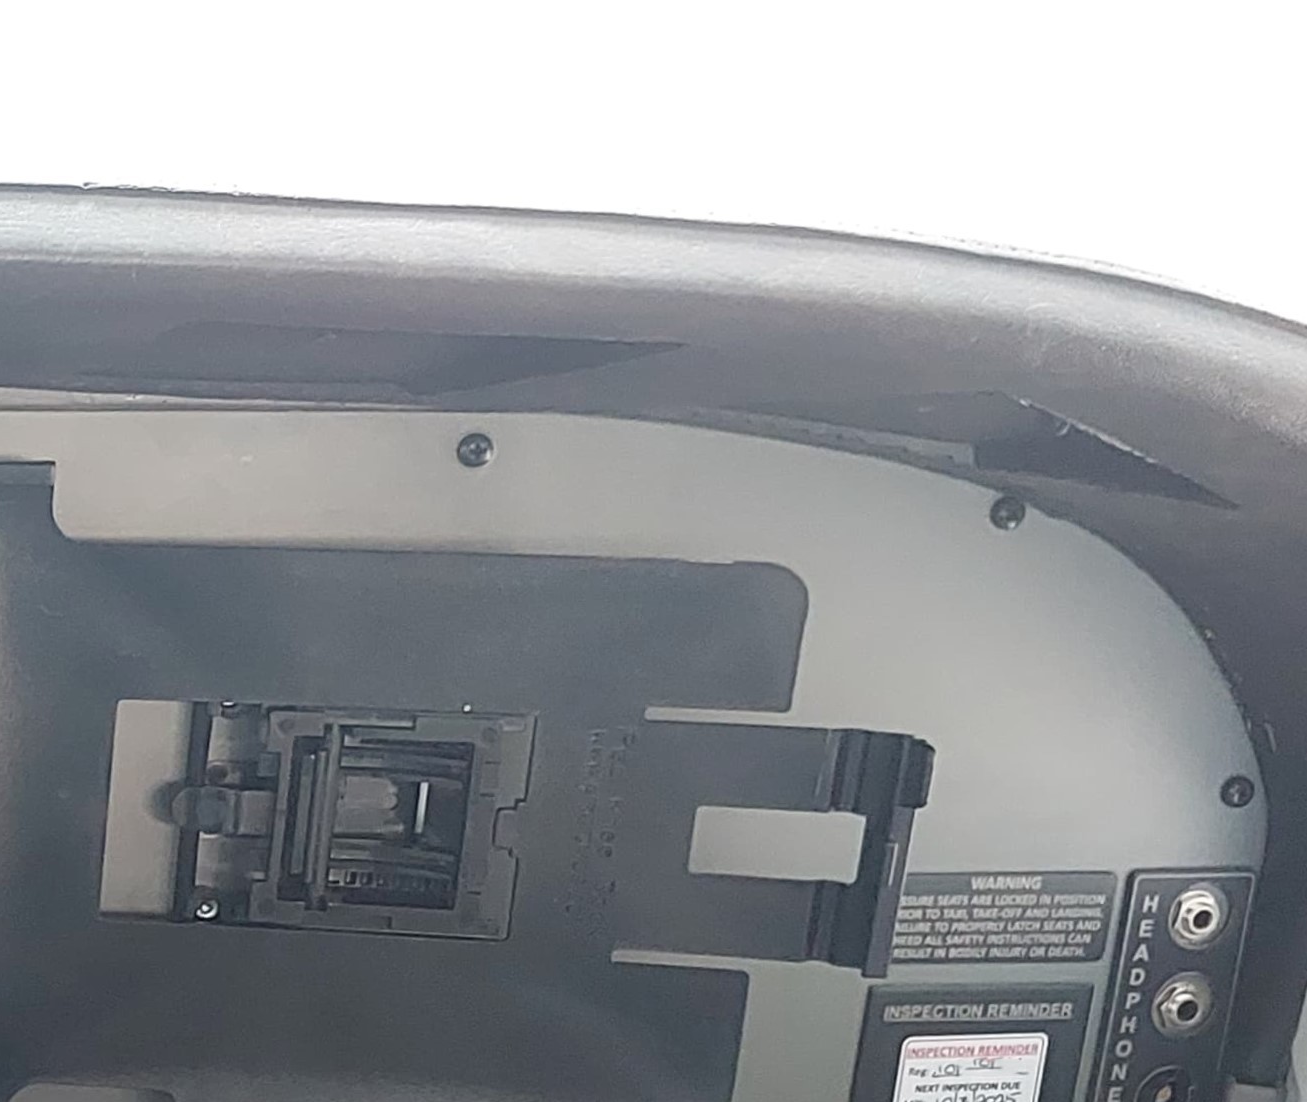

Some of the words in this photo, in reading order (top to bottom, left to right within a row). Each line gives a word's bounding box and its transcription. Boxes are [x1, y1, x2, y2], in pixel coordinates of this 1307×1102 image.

[884, 1005, 983, 1021] INSPECTION
[987, 1003, 1073, 1019] REMINDER
[915, 1084, 938, 1092] NEXT
[942, 1082, 998, 1091] INSPECTION
[1001, 1082, 1021, 1090] DUE
